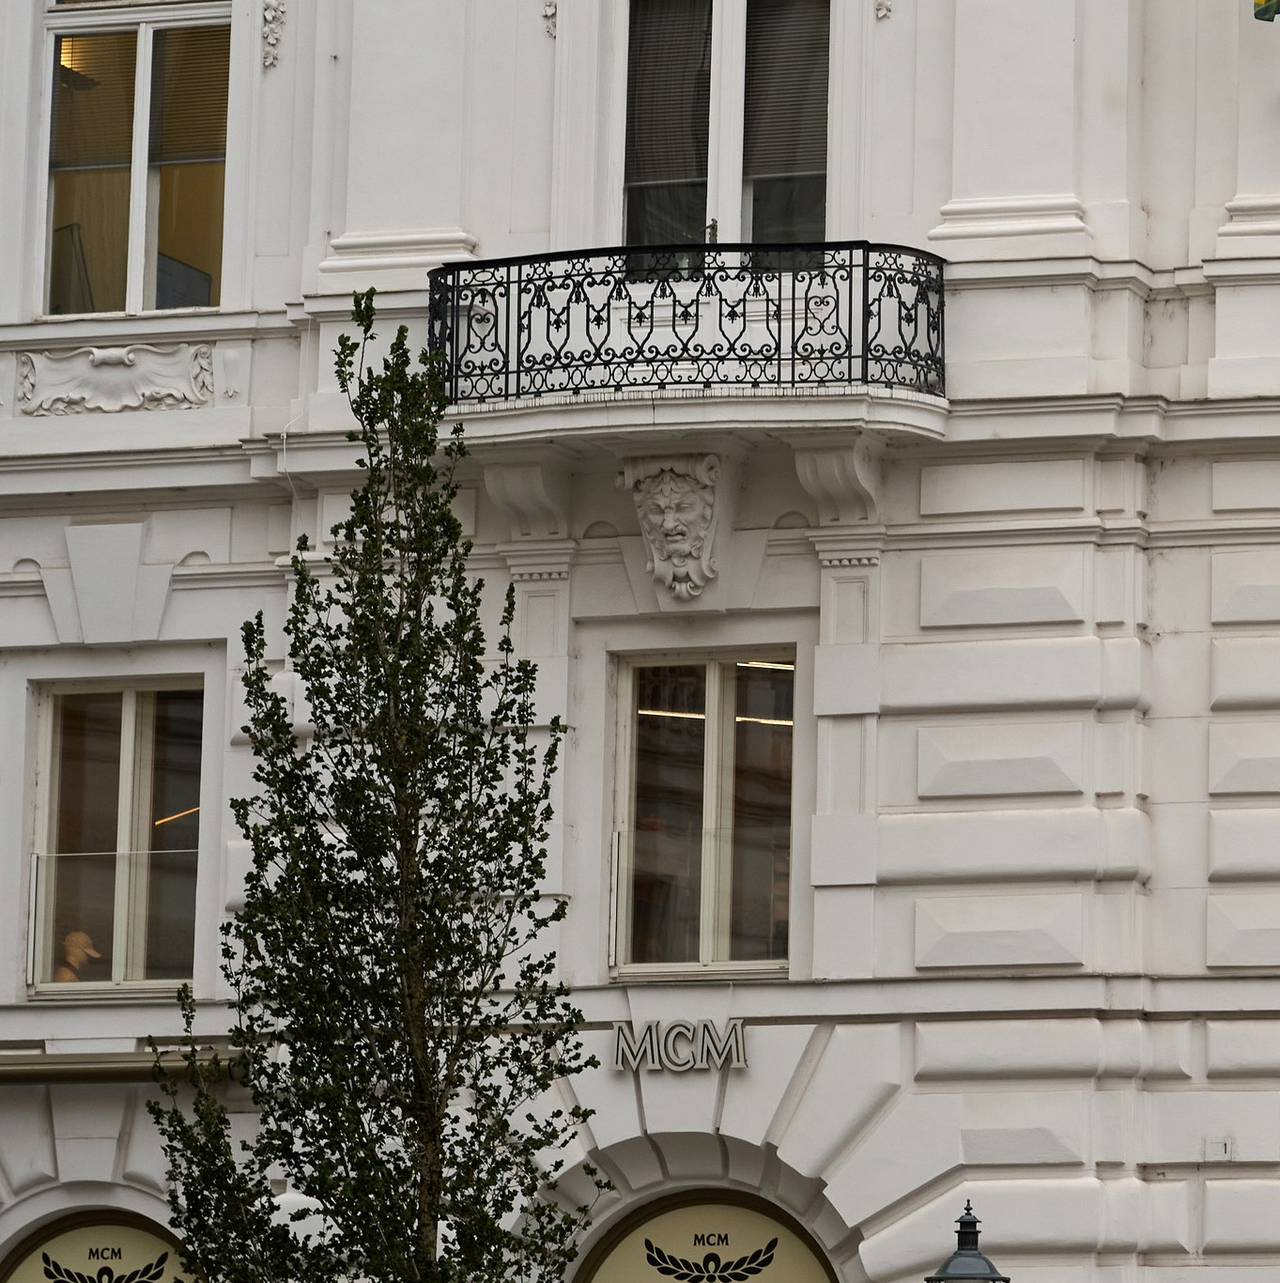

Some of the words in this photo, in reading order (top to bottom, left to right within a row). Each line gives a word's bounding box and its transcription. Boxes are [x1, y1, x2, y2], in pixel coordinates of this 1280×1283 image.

[610, 1019, 748, 1072] MCM
[693, 1232, 729, 1246] MCM
[88, 1247, 122, 1261] MCM
